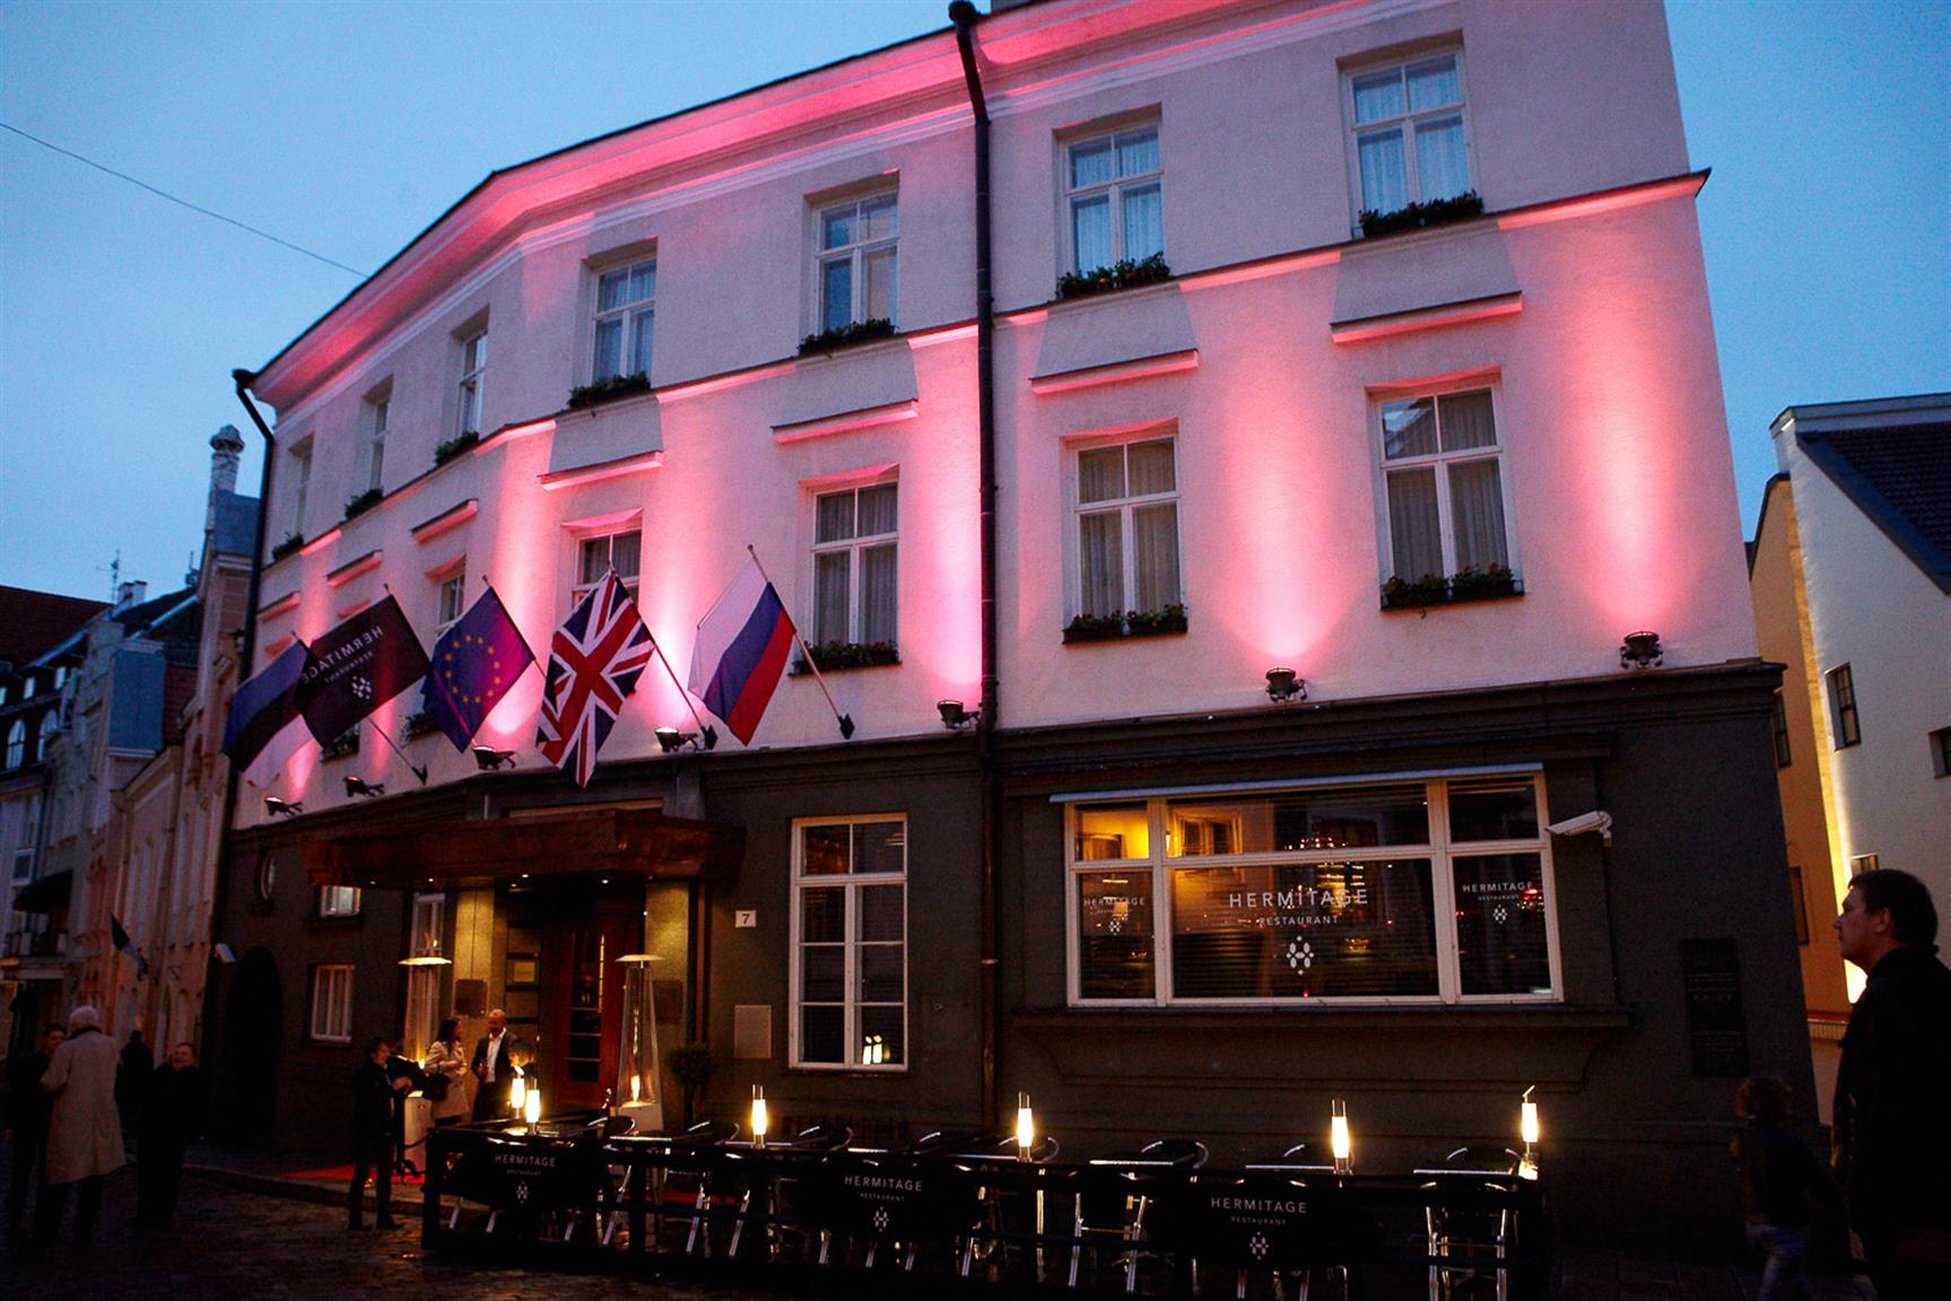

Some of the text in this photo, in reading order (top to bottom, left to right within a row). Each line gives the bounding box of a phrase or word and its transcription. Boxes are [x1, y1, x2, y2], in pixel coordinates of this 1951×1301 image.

[1229, 888, 1368, 909] HERMITAGE
[741, 913, 750, 924] 7
[1258, 915, 1339, 927] RESTAURANT
[495, 1153, 557, 1167] HERMITAGE
[844, 1175, 924, 1192] HERMITAGE
[1210, 1196, 1308, 1214] HERMITAGE
